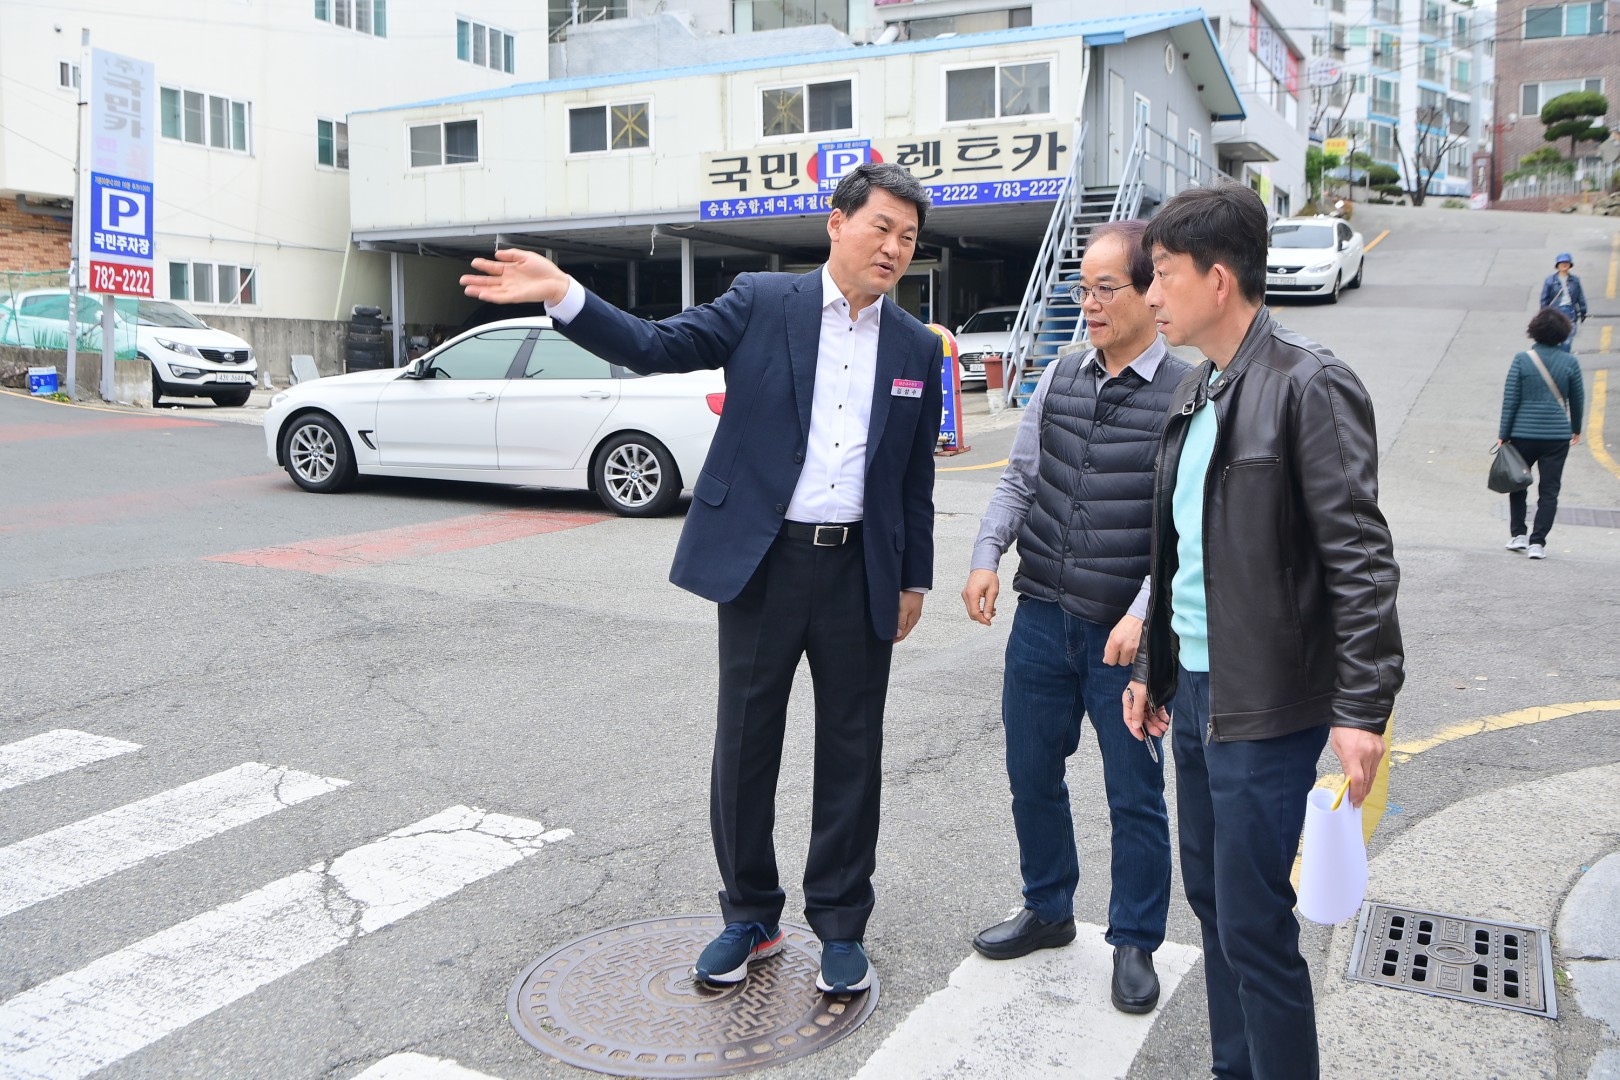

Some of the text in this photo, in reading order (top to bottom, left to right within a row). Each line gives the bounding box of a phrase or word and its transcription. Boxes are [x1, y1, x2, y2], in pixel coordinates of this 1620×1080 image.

[708, 131, 1067, 193] 국민 렌트카
[833, 153, 859, 174] P
[925, 185, 978, 202] 2-2222
[109, 193, 140, 228] P
[94, 231, 150, 255] 국민주차장
[94, 265, 151, 294] 782-2222
